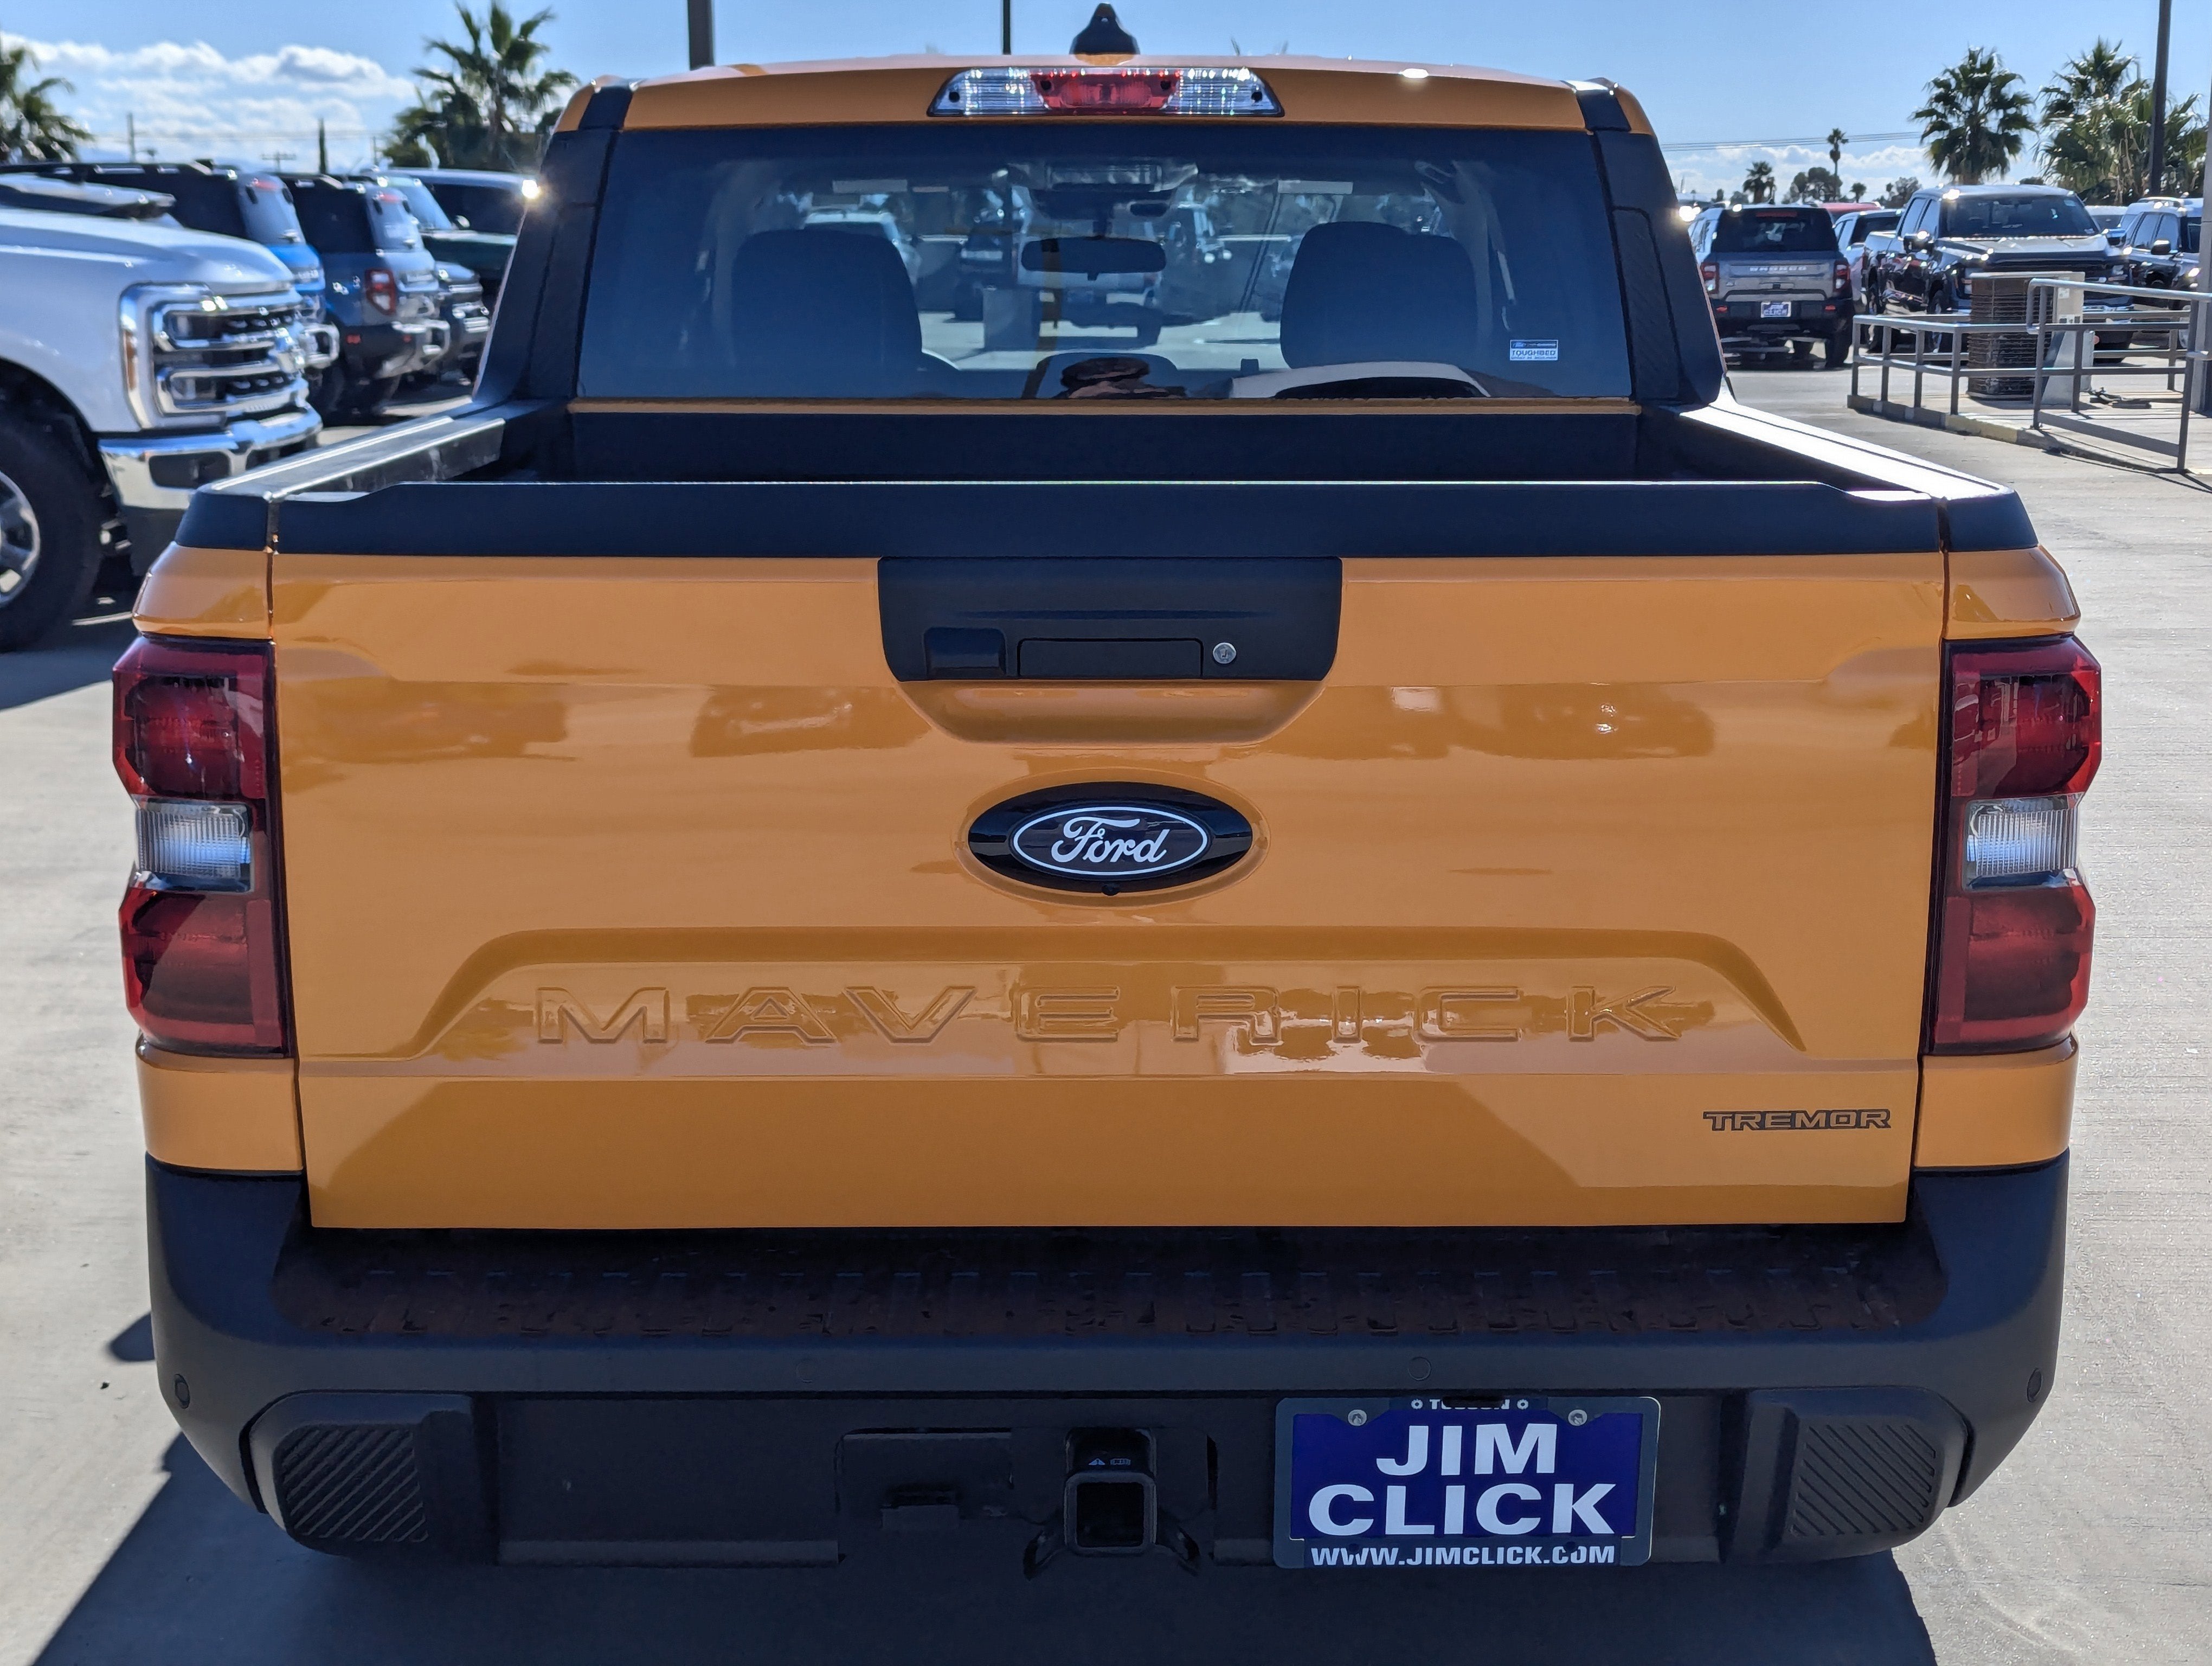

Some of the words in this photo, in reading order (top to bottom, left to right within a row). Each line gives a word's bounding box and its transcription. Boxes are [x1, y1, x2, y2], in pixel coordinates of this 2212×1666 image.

[1051, 816, 1170, 863] Ford
[537, 986, 1682, 1044] MAVERICK
[1703, 1108, 1892, 1131] TREMOR
[1376, 1424, 1558, 1476] JIM
[1308, 1483, 1616, 1536] CLICK
[1311, 1546, 1615, 1566] WWW.JIMCLICK.COM
